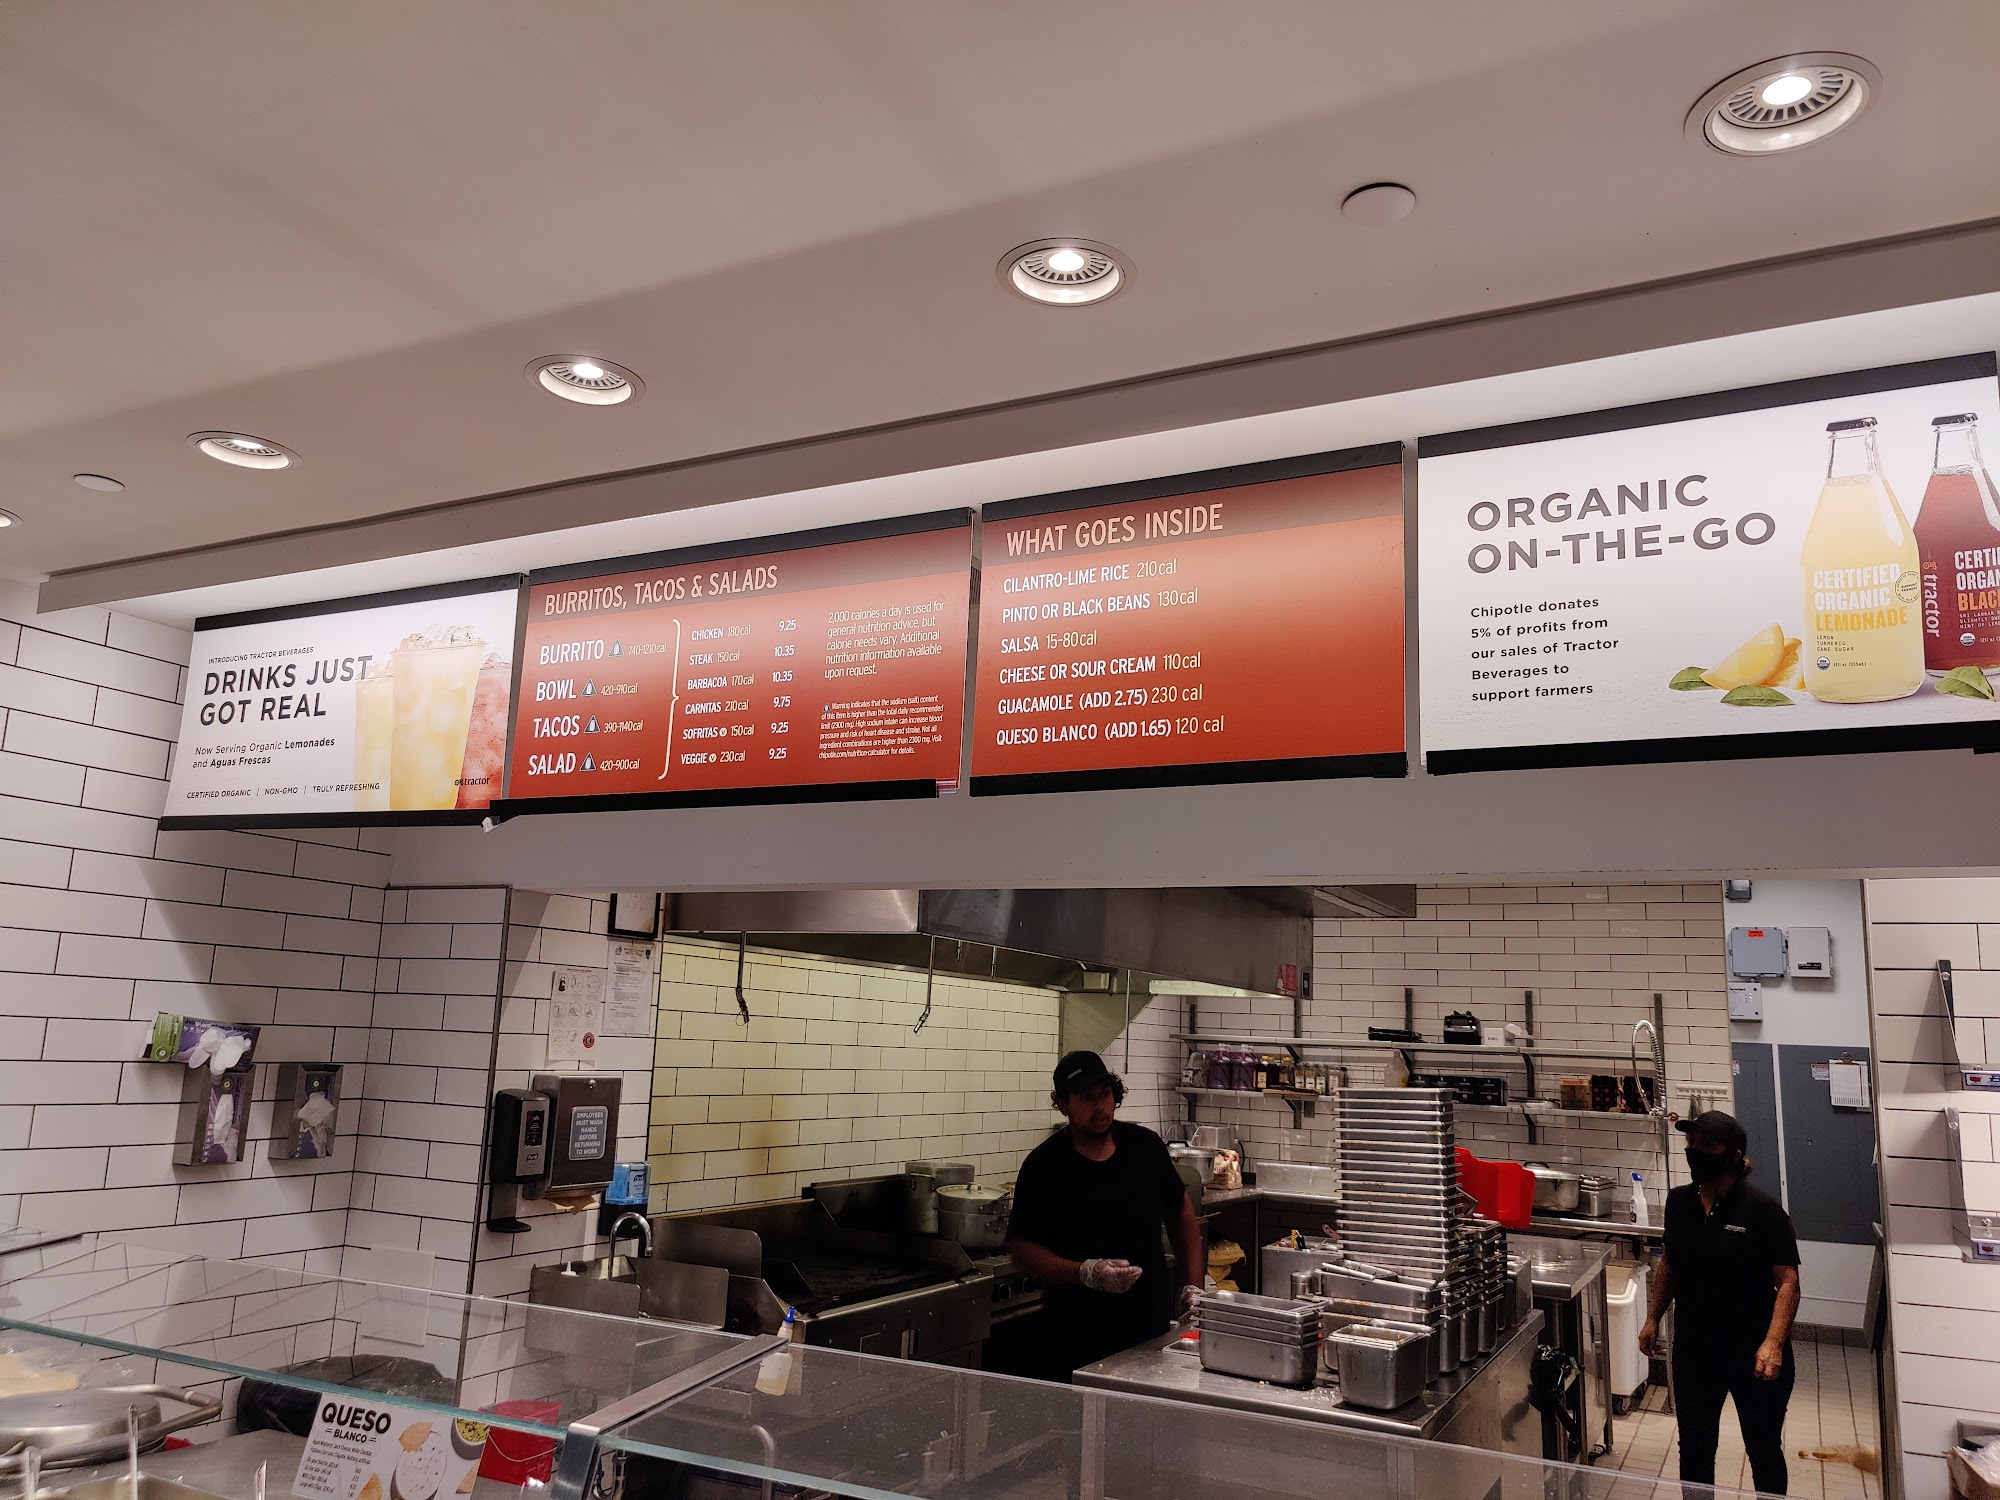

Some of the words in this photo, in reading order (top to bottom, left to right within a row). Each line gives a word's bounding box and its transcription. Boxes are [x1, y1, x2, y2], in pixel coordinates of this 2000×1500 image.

[1467, 475, 1709, 531] ORGANIC
[1007, 525, 1068, 557] WHAT
[1075, 515, 1136, 548] GOES
[1145, 503, 1224, 540] INSIDE
[1467, 512, 1776, 574] ON-THE-GO
[1003, 568, 1097, 594] CILANTRO-LIME
[1101, 564, 1130, 582] RICE
[1814, 562, 1900, 589] CERTIFIED
[545, 585, 628, 616] BURRITOS,
[634, 577, 686, 605] TACOS
[691, 574, 703, 598] &
[708, 565, 778, 596] SALADS
[1814, 587, 1891, 611] ORGANIC
[1958, 590, 2000, 611] BLAC
[828, 611, 850, 624] 2,000
[851, 608, 880, 621] calories
[882, 609, 887, 618] a
[889, 605, 902, 618] day
[905, 604, 911, 615] is
[912, 601, 932, 614] used
[934, 600, 945, 612] for
[1002, 605, 1038, 624] PINTO
[1041, 603, 1059, 620] OR
[1063, 598, 1104, 617] BLACK
[1108, 593, 1151, 613] BEANS
[1470, 602, 1533, 619] Chipotle
[1538, 598, 1600, 613] donates
[1923, 574, 1941, 638] tractor
[692, 628, 724, 640] CHICKEN
[779, 619, 797, 632] 9.25
[828, 624, 856, 639] general
[858, 621, 891, 634] nutrition
[893, 618, 920, 631] advice,
[922, 615, 936, 627] but
[1471, 628, 1491, 638] 5%
[1497, 625, 1512, 636] of
[1517, 621, 1567, 637] profits
[1572, 618, 1609, 630] from
[1815, 606, 1909, 633] LEMONADE
[827, 638, 852, 651] calorie
[854, 635, 878, 648] needs
[880, 635, 898, 647] vary.
[900, 629, 940, 643] Additional
[1000, 636, 1039, 654] SALSA
[1471, 649, 1495, 660] our
[1501, 645, 1537, 658] sales
[1543, 643, 1558, 654] of
[1563, 638, 1619, 652] Tractor
[208, 654, 248, 665] INTRODUCING
[250, 651, 277, 660] TRACTOR
[278, 647, 314, 657] BEVERAGES
[540, 639, 605, 666] BURRITO
[689, 653, 714, 666] STEAK
[774, 645, 795, 657] 10.35
[826, 651, 858, 665] nutrition
[860, 647, 905, 661] information
[907, 643, 942, 657] available
[204, 664, 297, 696] DRINKS
[306, 655, 373, 685] JUST
[688, 677, 728, 690] BARBACOA
[772, 671, 793, 683] 10.35
[825, 668, 844, 680] upon
[846, 663, 878, 678] request.
[999, 665, 1046, 684] CHEESE
[1050, 664, 1067, 680] OR
[1071, 660, 1107, 679] SOUR
[1110, 656, 1156, 675] CREAM
[1472, 665, 1548, 681] Beverages
[1553, 664, 1570, 674] to
[536, 679, 577, 702] BOWL
[998, 694, 1074, 715] GUACAMOLE
[1079, 691, 1112, 711] (ADD
[1114, 688, 1148, 707] 2.75)
[1151, 686, 1177, 704] 230
[1181, 683, 1203, 701] cal
[1472, 688, 1530, 702] support
[1535, 684, 1593, 697] farmers
[200, 699, 252, 726] GOT
[261, 693, 327, 722] REAL
[685, 702, 721, 715] CARNITAS
[773, 696, 791, 708] 9.75
[533, 715, 581, 739] TACOS
[683, 727, 718, 740] SOFRITAS
[771, 722, 789, 734] 9.25
[996, 727, 1038, 746] QUESO
[1042, 723, 1098, 743] BLANCO
[1104, 721, 1137, 741] (ADD
[1140, 719, 1172, 738] 1.65)
[1175, 717, 1199, 735] 120
[1203, 715, 1224, 732] cal
[195, 747, 213, 755] Now
[215, 744, 246, 755] Serving
[250, 741, 282, 753] Organic
[284, 738, 335, 749] Lemonades
[681, 752, 708, 765] VEGGIE
[769, 748, 787, 760] 9.25
[193, 759, 208, 769] and
[210, 757, 236, 769] Aguas
[239, 756, 271, 766] Frescas
[528, 752, 577, 776] SALAD
[186, 790, 220, 799] CERTIFIED
[221, 789, 252, 798] ORGANIC
[264, 787, 299, 796] NON-GMO
[312, 785, 334, 793] TRULY
[335, 783, 380, 793] REFRESHING
[321, 1402, 392, 1434] QUESO
[334, 1429, 368, 1443] BLANCO
